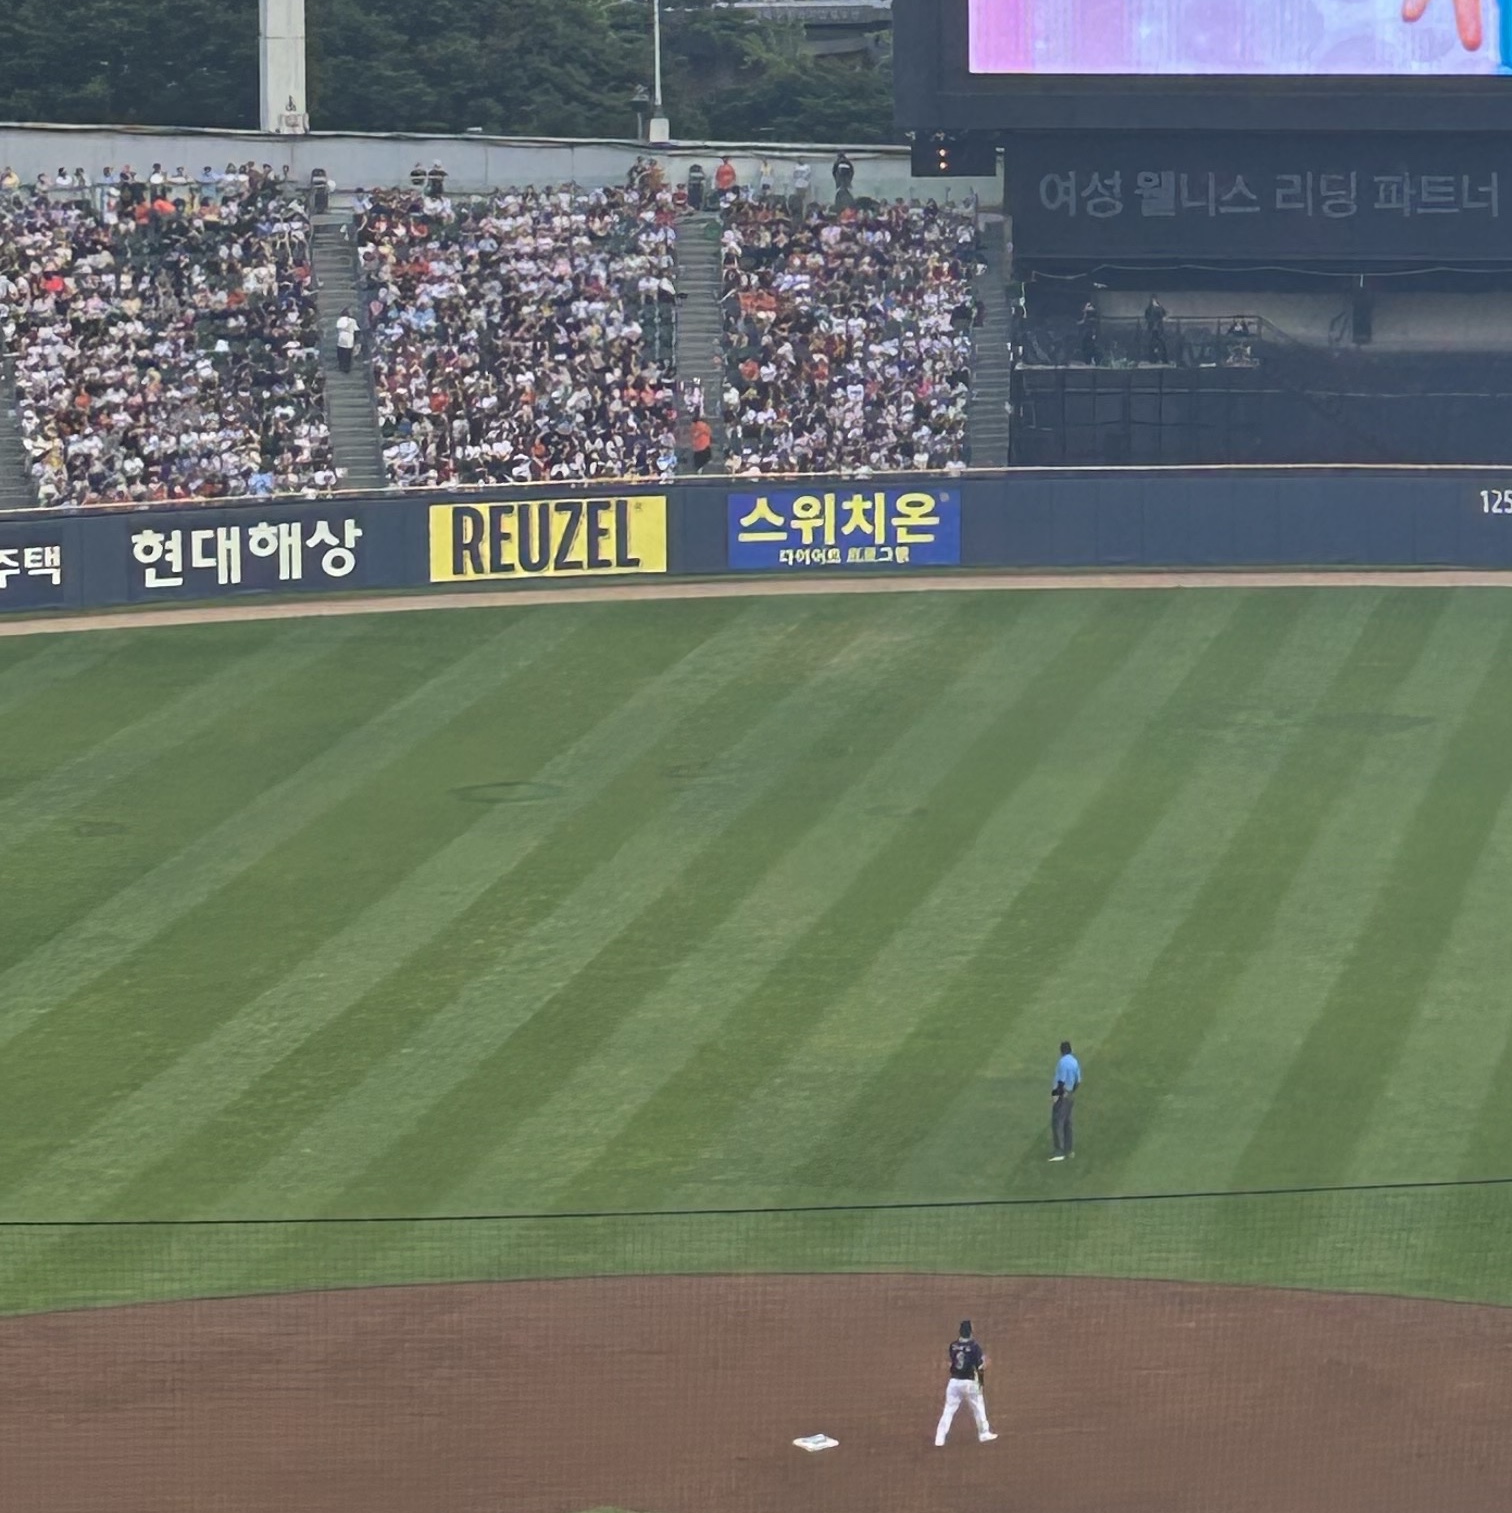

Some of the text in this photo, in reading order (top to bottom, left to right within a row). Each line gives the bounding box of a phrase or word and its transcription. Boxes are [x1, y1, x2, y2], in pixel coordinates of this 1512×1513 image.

[1039, 170, 1499, 219] 여성 웰니스 리딩 파트너
[452, 500, 640, 575] REUZEL
[738, 492, 940, 545] 스위치온
[0, 545, 61, 589] 주택
[131, 518, 363, 588] 현대해상
